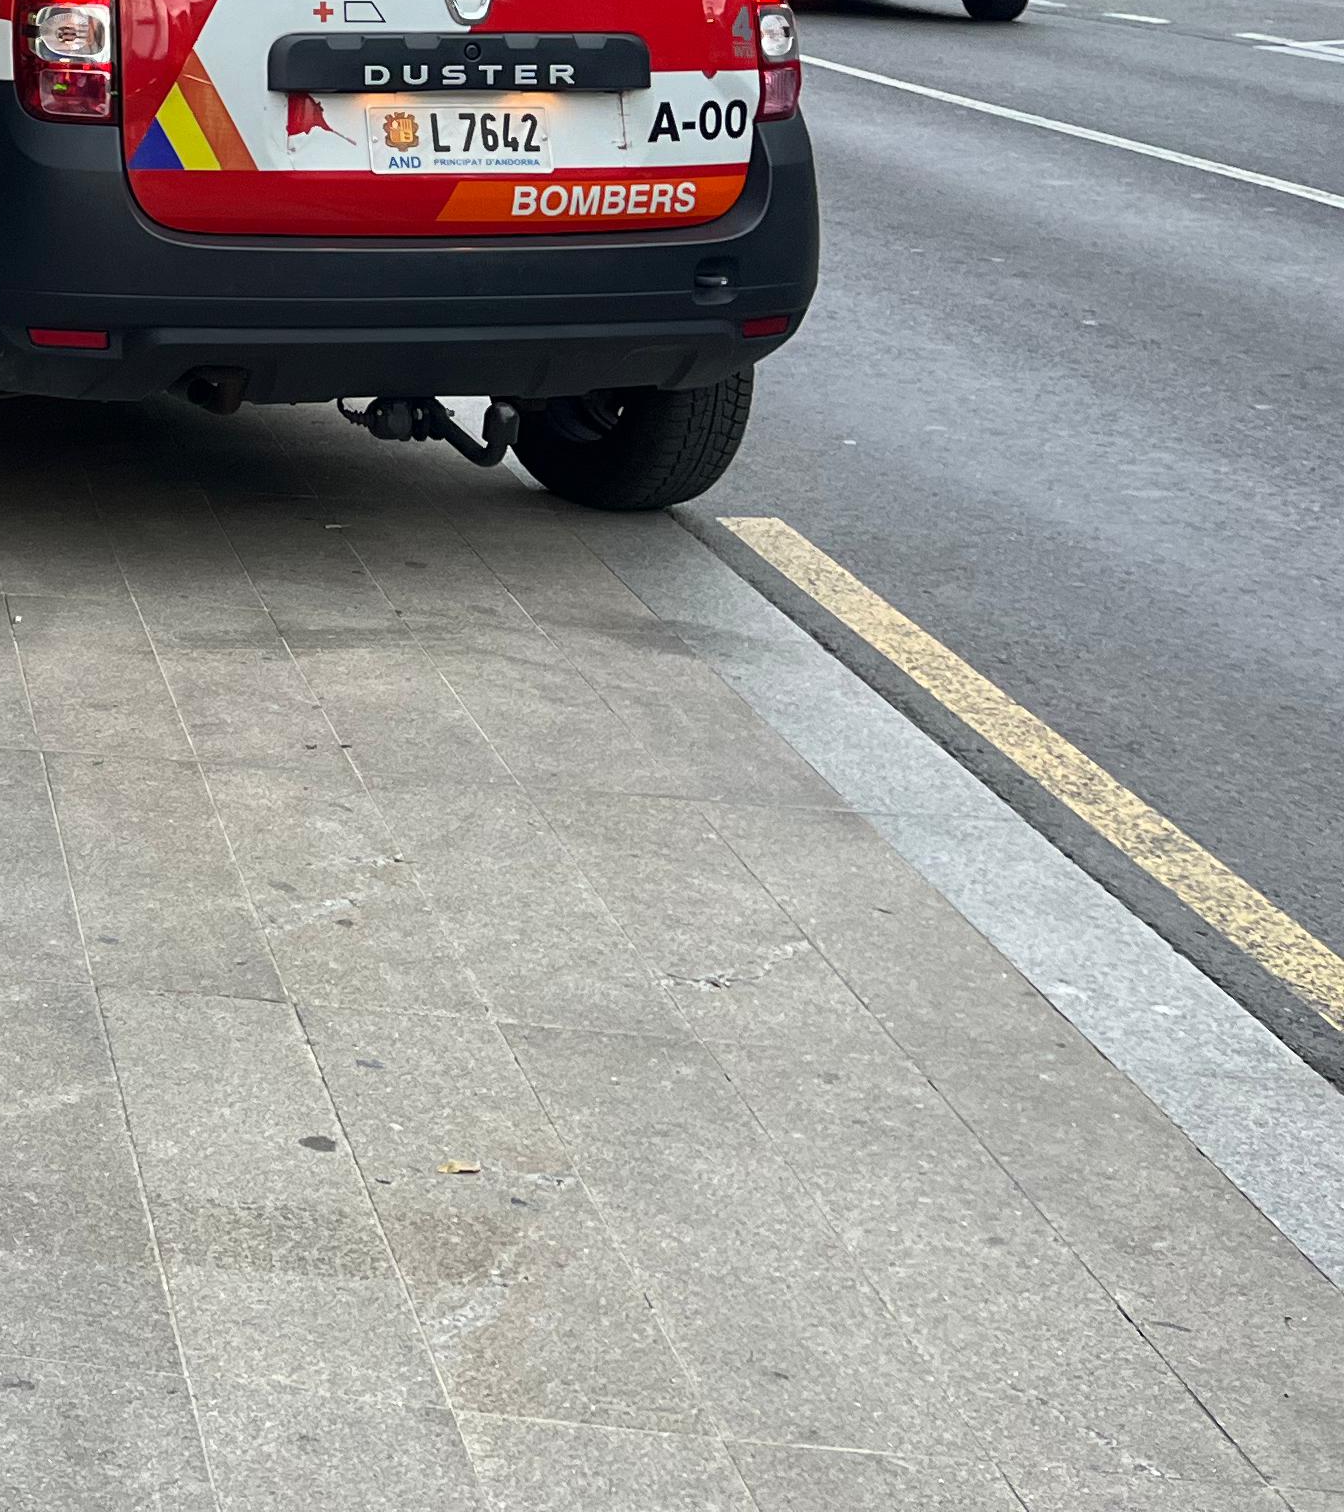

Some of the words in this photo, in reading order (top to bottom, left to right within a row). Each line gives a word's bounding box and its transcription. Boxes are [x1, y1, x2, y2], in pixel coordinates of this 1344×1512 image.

[364, 64, 575, 85] DUSTER
[430, 113, 451, 153] L
[458, 112, 541, 153] 7642
[647, 99, 748, 143] A-00
[388, 156, 422, 169] AND
[433, 158, 482, 167] PRINCIPAT
[486, 158, 541, 167] D'ANDORRA
[511, 181, 697, 217] BOMBERS
